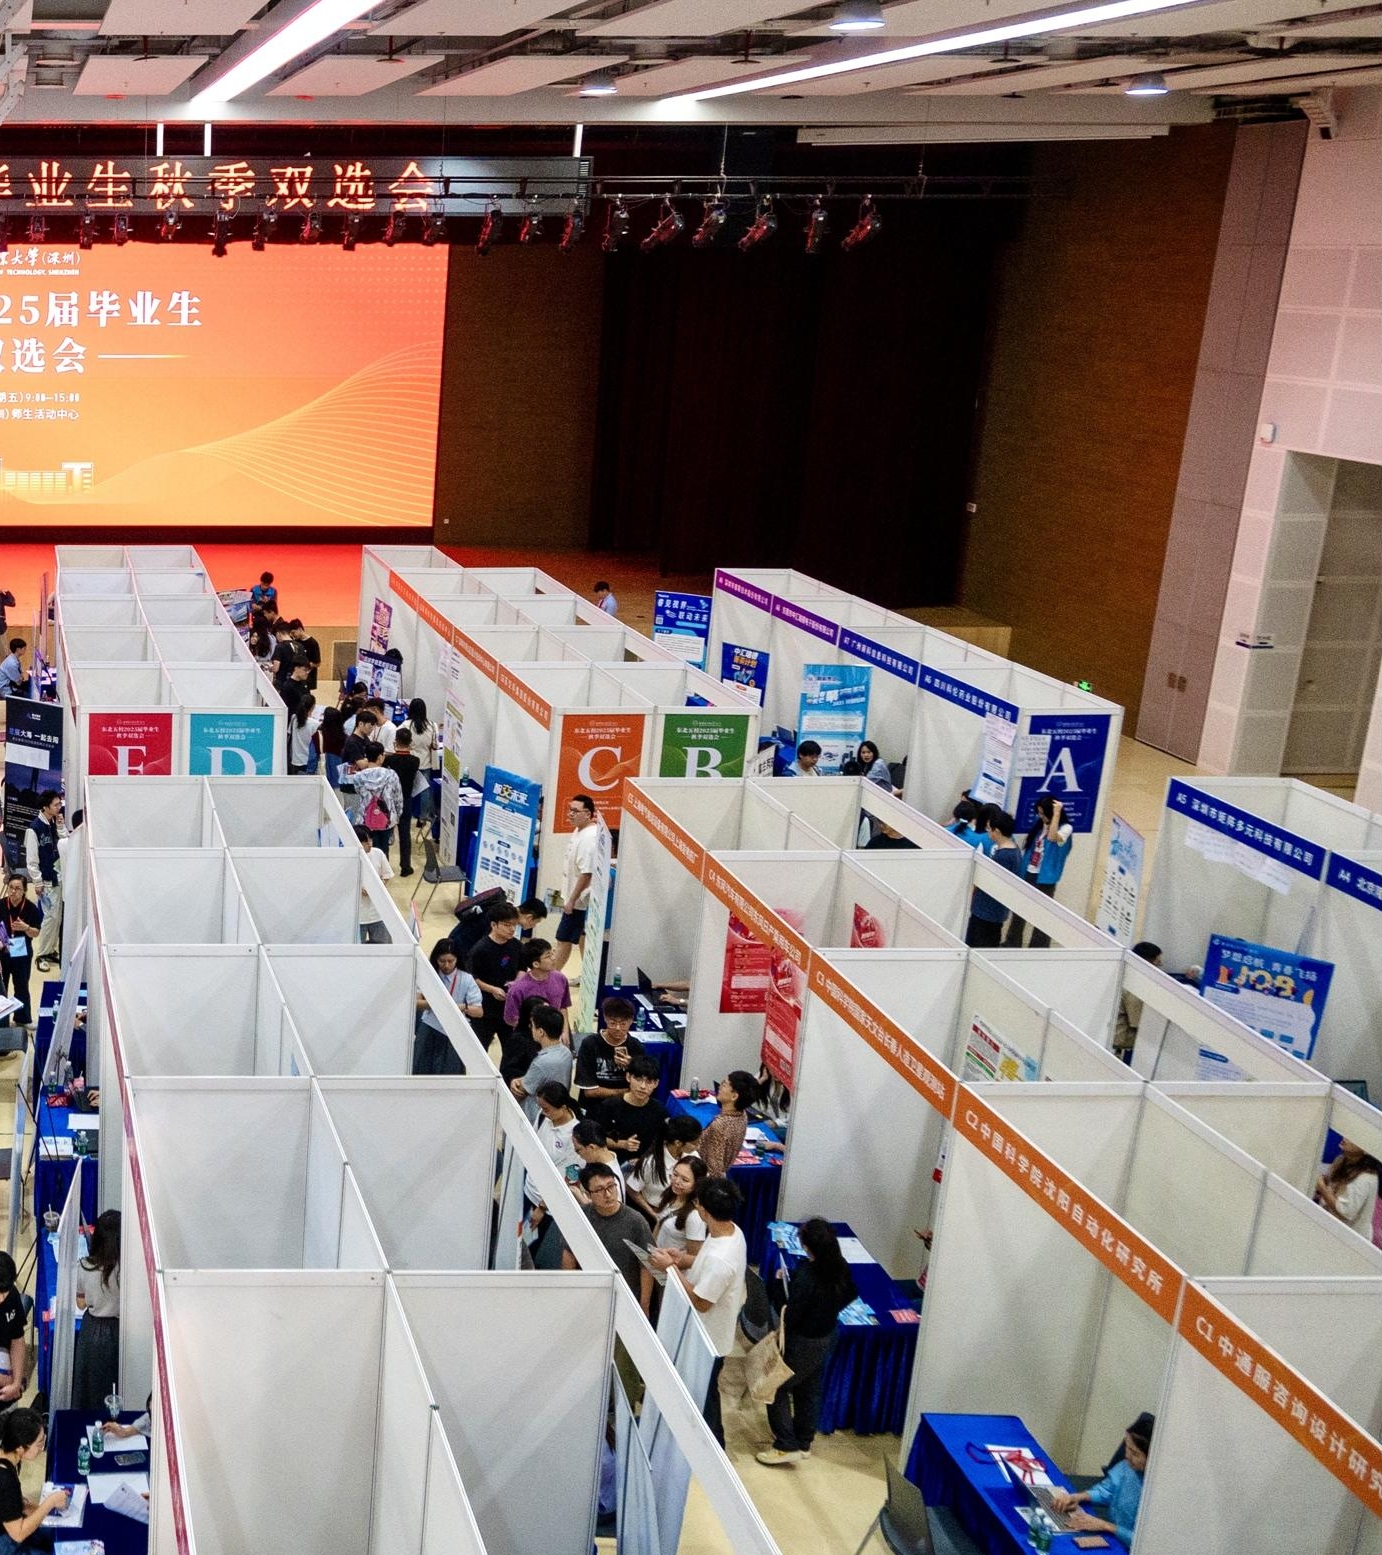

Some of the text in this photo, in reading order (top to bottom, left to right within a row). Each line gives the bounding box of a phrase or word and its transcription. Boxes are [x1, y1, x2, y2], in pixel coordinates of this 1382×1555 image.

[578, 746, 622, 792] C
[683, 746, 723, 778] B
[1036, 747, 1083, 793] A
[1191, 797, 1314, 868] 深圳市矩阵多元科技有限公司
[965, 1109, 1164, 1297] C2 中国科学院沈阳自动化研究所
[1195, 1315, 1215, 1344] C1
